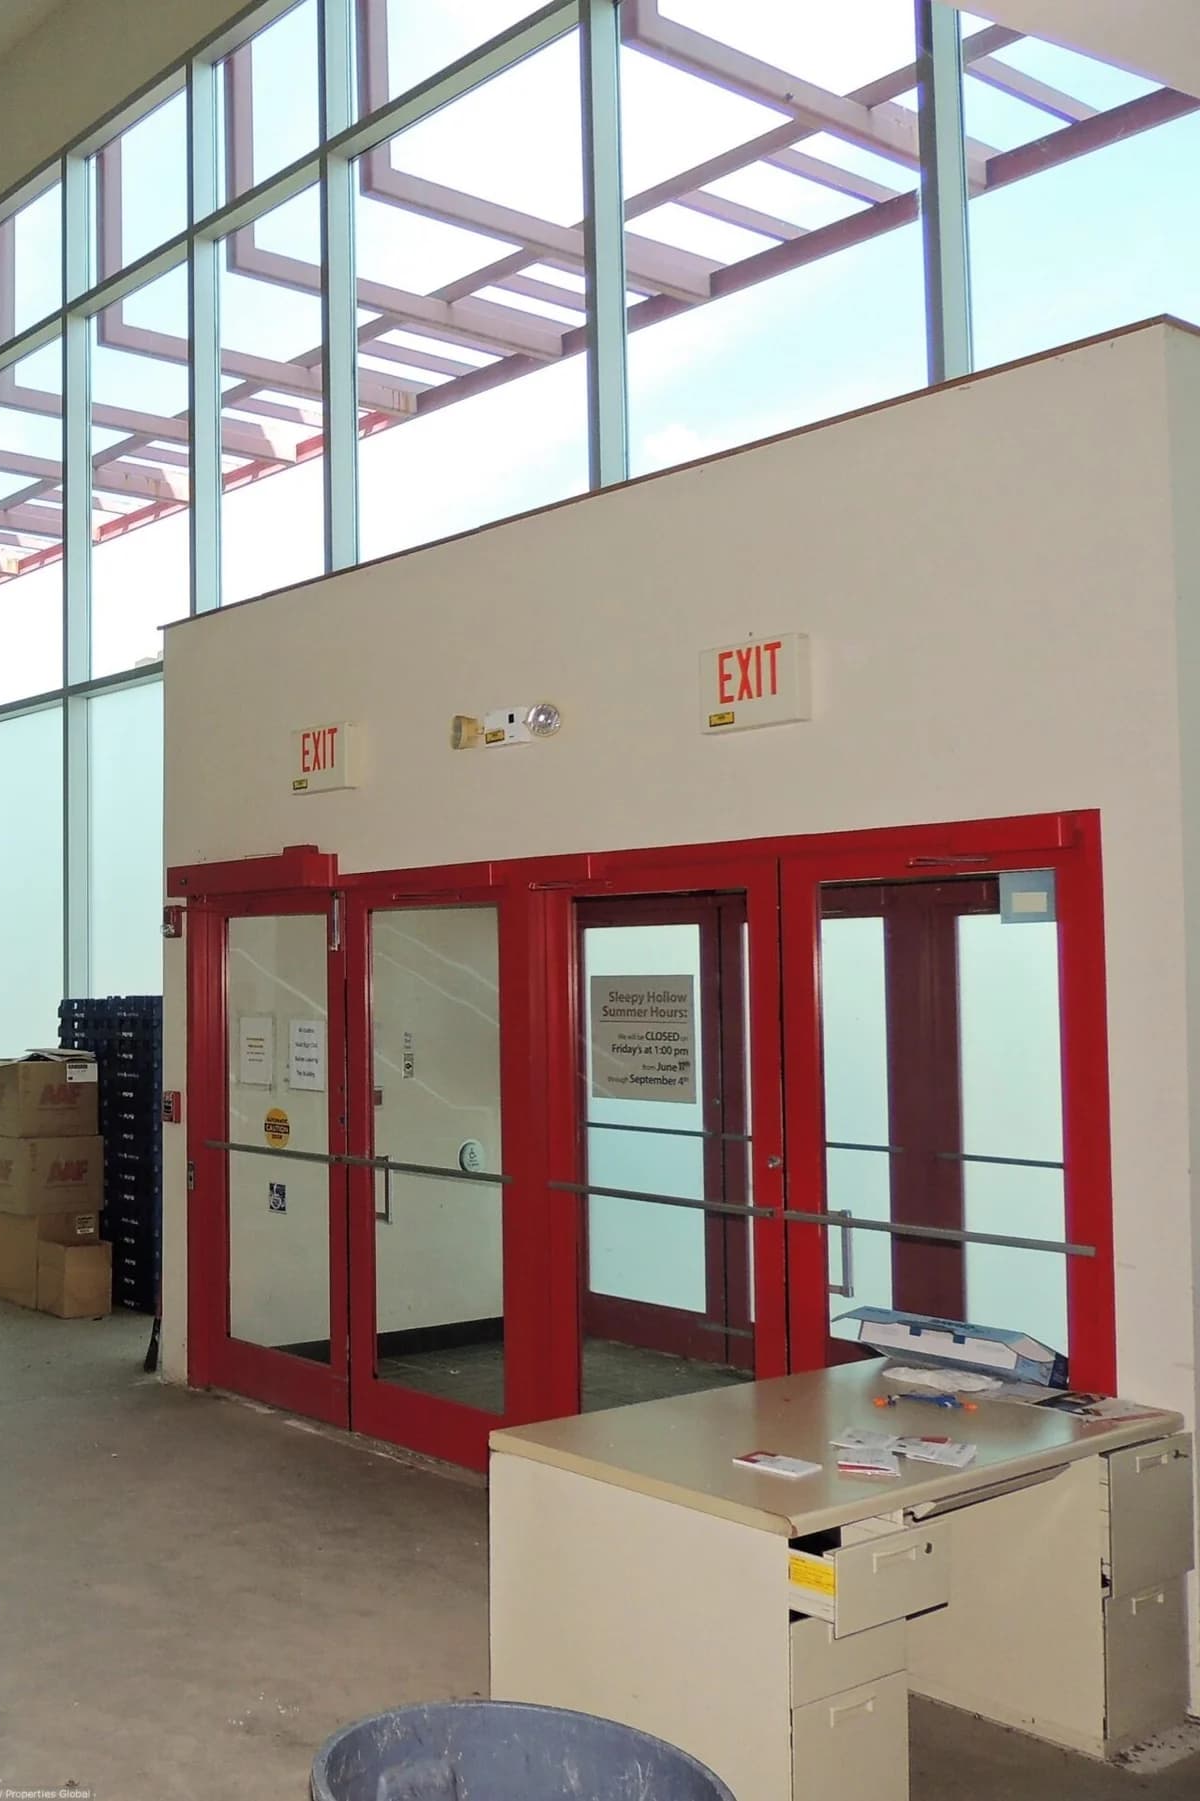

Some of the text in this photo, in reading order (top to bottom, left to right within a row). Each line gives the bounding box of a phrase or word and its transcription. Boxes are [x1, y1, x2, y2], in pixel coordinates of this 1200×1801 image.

[718, 641, 782, 704] EXIT
[302, 727, 337, 772] EXIT
[608, 991, 688, 1005] Sleepy Hollow
[602, 1005, 689, 1018] Summer Hours:
[645, 1031, 681, 1041] CLOSED
[644, 1046, 653, 1054] at
[654, 1046, 673, 1055] 1:00
[674, 1048, 689, 1057] pm
[656, 1062, 678, 1072] June
[629, 1074, 677, 1086] September
